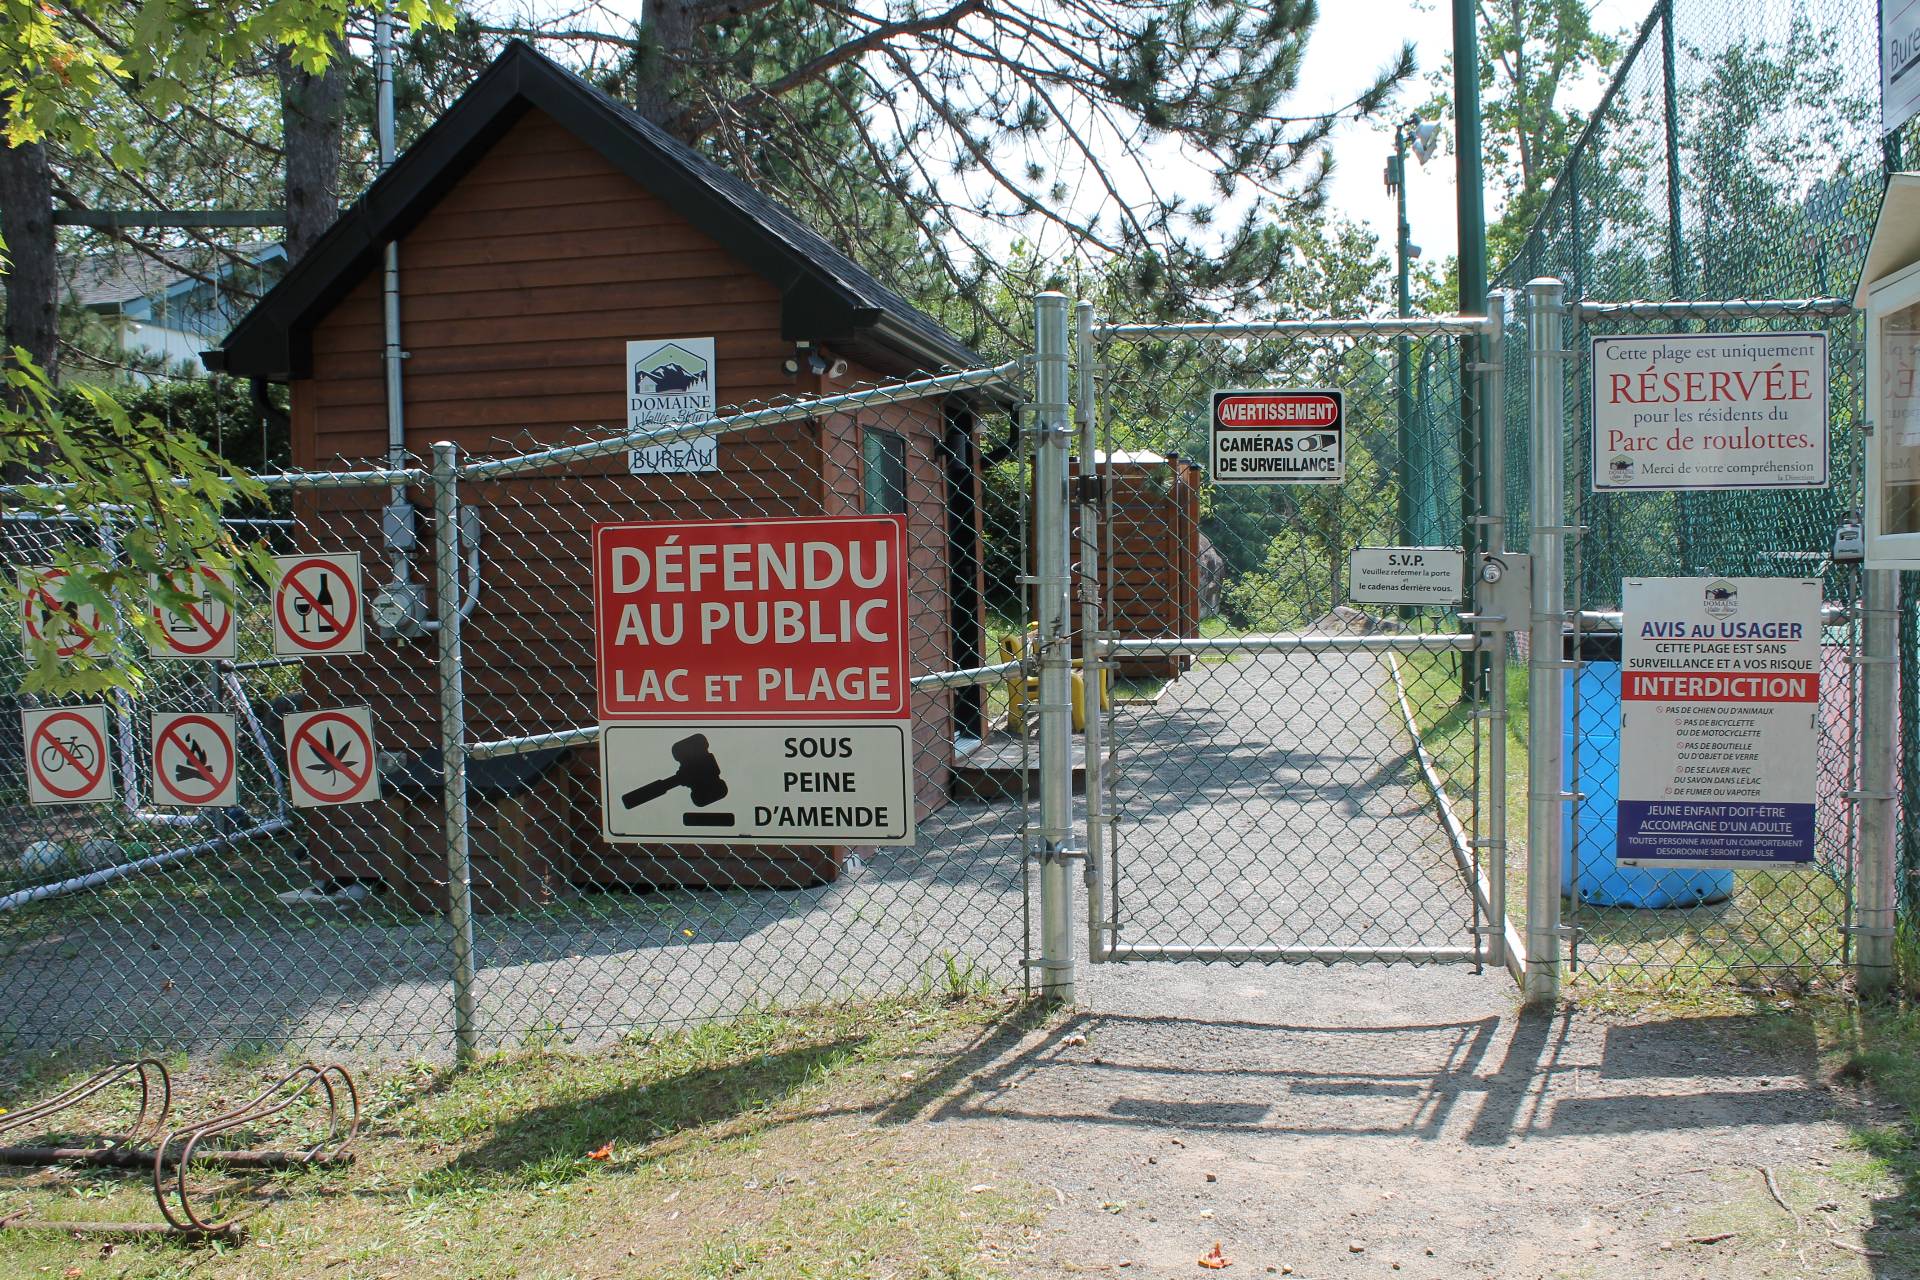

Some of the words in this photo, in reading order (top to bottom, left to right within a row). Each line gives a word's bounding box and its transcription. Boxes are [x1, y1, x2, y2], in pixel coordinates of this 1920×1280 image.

[1606, 345, 1647, 360] Cette
[1652, 344, 1692, 364] plage
[1696, 347, 1716, 358] est
[1722, 344, 1815, 361] uniquement
[1608, 363, 1813, 404] RÉSERVÉE
[632, 395, 711, 411] DOMAINE
[1222, 403, 1334, 420] AVERTISSEMENT
[1634, 412, 1670, 428] pour
[1675, 407, 1693, 422] les
[1698, 406, 1763, 421] résidents
[1768, 405, 1789, 420] du
[1220, 433, 1294, 452] CAMÉRAS
[1608, 430, 1658, 452] Parc
[1666, 427, 1694, 450] de
[1703, 426, 1815, 450] roulottes.
[633, 448, 712, 469] BUREAU
[1220, 458, 1238, 472] DE
[1241, 457, 1335, 472] SURVEILLANCE
[1641, 463, 1674, 474] Merci
[1678, 461, 1692, 474] de
[1695, 464, 1724, 473] votre
[1726, 460, 1814, 476] compréhension
[611, 535, 888, 594] DÉFENDU
[1388, 554, 1425, 566] S.V.P.
[1361, 568, 1390, 576] Veuillez
[1391, 568, 1421, 576] refermer
[1422, 569, 1430, 577] la
[1430, 570, 1451, 578] porte
[1359, 582, 1366, 590] le
[1367, 583, 1399, 591] cadenas
[1400, 583, 1431, 592] derrière
[614, 603, 684, 646] AU
[700, 598, 889, 645] PUBLIC
[1640, 621, 1686, 637] AVIS
[1691, 624, 1715, 638] AU
[1721, 622, 1802, 638] USAGER
[1655, 643, 1690, 653] CETTE
[1693, 643, 1730, 653] PLAGE
[1733, 644, 1754, 653] EST
[1756, 644, 1787, 654] SANS
[1629, 658, 1714, 669] SURVEILLANCE
[1717, 659, 1731, 669] ET
[1743, 659, 1768, 669] VOS
[1770, 660, 1813, 671] RISQUE
[615, 669, 689, 702] LAC
[705, 675, 742, 702] ET
[758, 666, 891, 701] PLAGE
[1633, 676, 1807, 698] INTERDICTION
[1665, 706, 1680, 714] PAS
[1681, 706, 1691, 714] DE
[1693, 706, 1716, 714] CHIEN
[1717, 707, 1729, 715] OU
[1730, 707, 1775, 715] D'ANIMAUX
[1699, 719, 1709, 727] DE
[1710, 719, 1756, 727] BICYCLETTE
[1676, 729, 1689, 737] OU
[1689, 729, 1700, 737] DE
[1701, 729, 1761, 737] MOTOCYCLETTE
[784, 737, 853, 758] SOUS
[1684, 742, 1699, 750] PAS
[1700, 742, 1710, 750] DE
[1711, 742, 1752, 751] BOUTIELLE
[1678, 752, 1690, 760] OU
[1690, 752, 1722, 760] D'OBJET
[1735, 753, 1760, 761] VERRE
[1684, 766, 1694, 774] DE
[1695, 766, 1706, 774] SE
[1706, 766, 1730, 774] LAVER
[1731, 767, 1752, 775] AVEC
[784, 771, 856, 793] PEINE
[1673, 776, 1686, 784] DU
[1687, 776, 1713, 784] SAVON
[1714, 776, 1735, 784] DANS
[1736, 777, 1745, 785] LE
[1746, 777, 1762, 785] LAC
[1685, 788, 1712, 796] FUMER
[1713, 788, 1726, 796] OU
[1727, 789, 1761, 797] VAPOTER
[754, 806, 889, 828] D'AMENDE
[1647, 805, 1681, 816] JEUNE
[1684, 806, 1727, 817] ENFANT
[1728, 805, 1786, 818] DOIT-ÊTRE
[1639, 820, 1717, 831] ACCOMPAGNE
[1719, 821, 1748, 832] D'UN
[1749, 822, 1793, 833] ADULTE
[1628, 837, 1658, 845] TOUTES
[1658, 837, 1699, 846] PERSONNE
[1700, 838, 1725, 846] AYANT
[1725, 838, 1738, 846] UN
[1739, 839, 1804, 847] COMPORTEMENT
[1656, 847, 1709, 856] DESORDONNE
[1710, 848, 1740, 857] SERONT
[1741, 849, 1775, 857] EXPULSE
